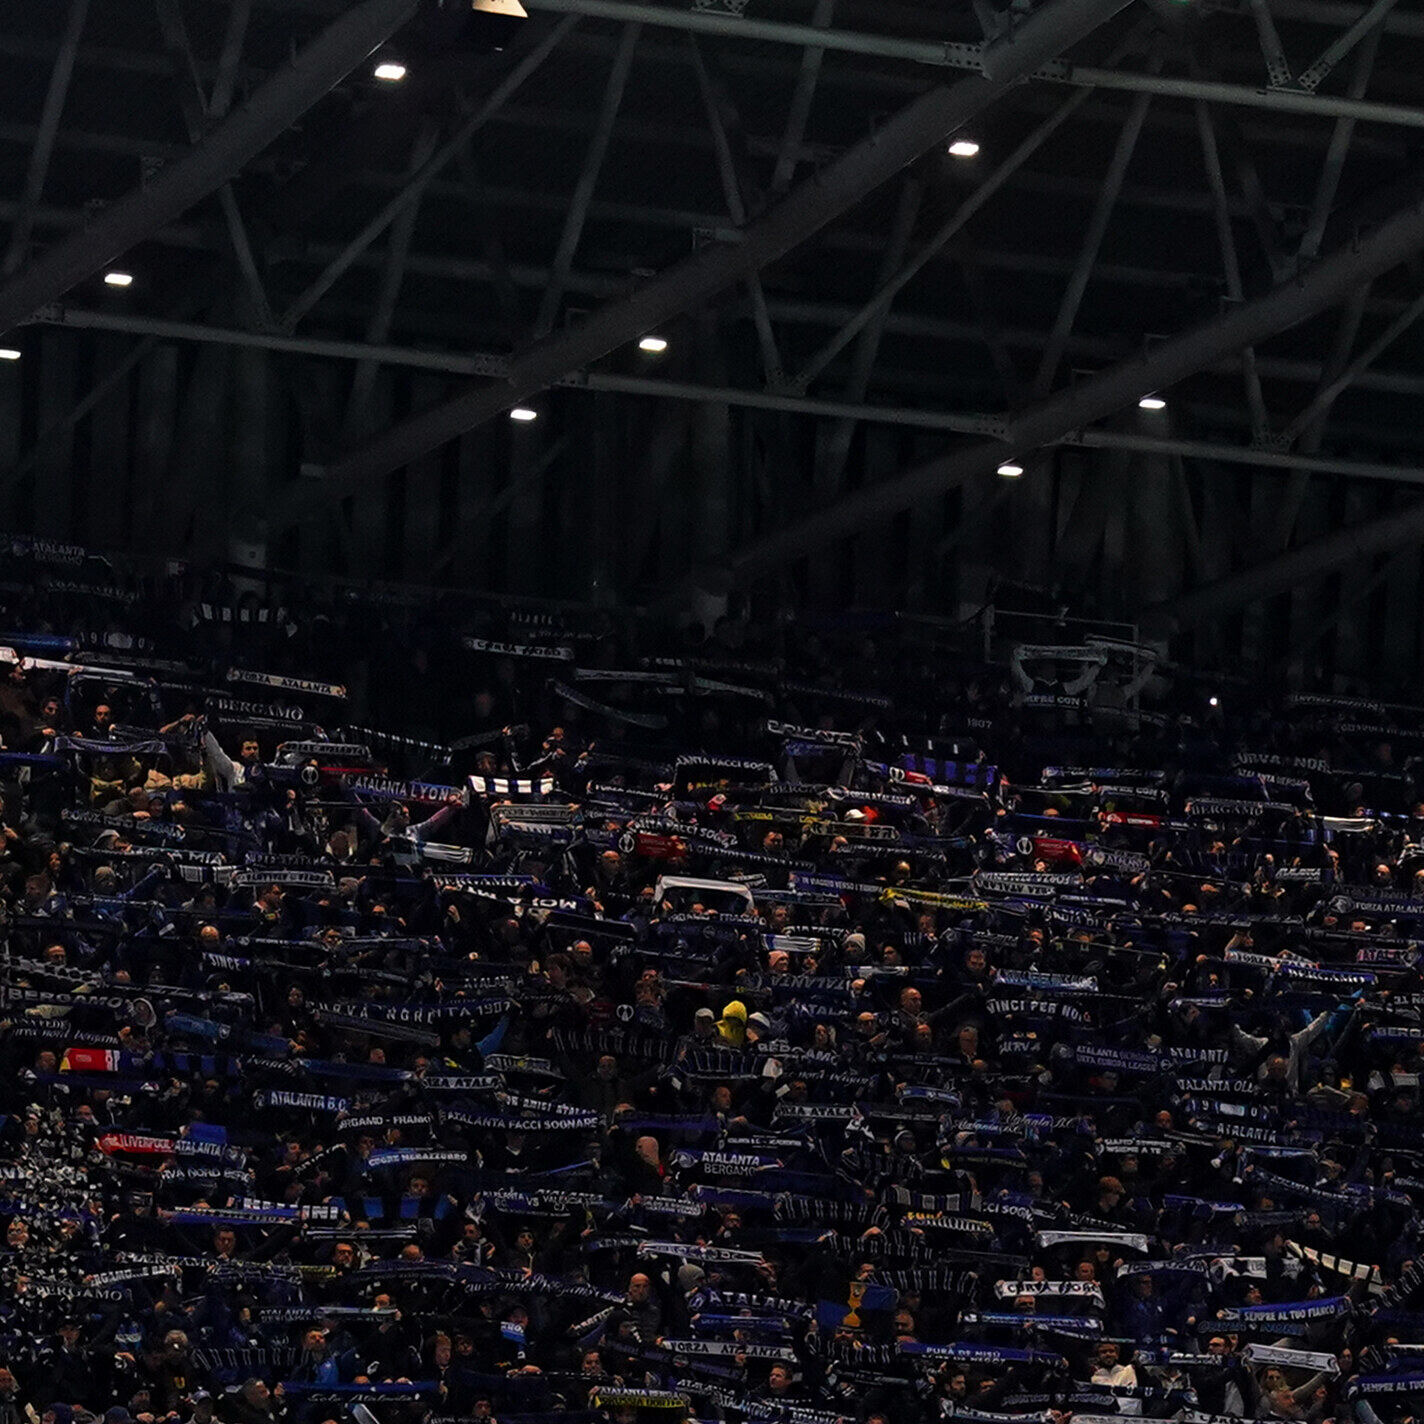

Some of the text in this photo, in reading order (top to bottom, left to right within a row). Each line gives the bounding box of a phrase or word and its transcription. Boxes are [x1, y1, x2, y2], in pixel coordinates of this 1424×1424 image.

[219, 699, 303, 720] BERGAMO
[411, 783, 450, 800] LYON
[8, 988, 123, 1008] BERGAMO
[270, 1092, 323, 1109] ATALANTA
[702, 1152, 760, 1166] ATALANTA
[710, 1291, 814, 1318] ATALANTA
[1244, 1311, 1276, 1321] SEMPRE
[1290, 1309, 1306, 1319] TUO
[1308, 1304, 1335, 1318] FIANCO
[1361, 1381, 1393, 1392] SEMPRE
[1395, 1382, 1406, 1391] AL
[1408, 1381, 1424, 1390] TUO
